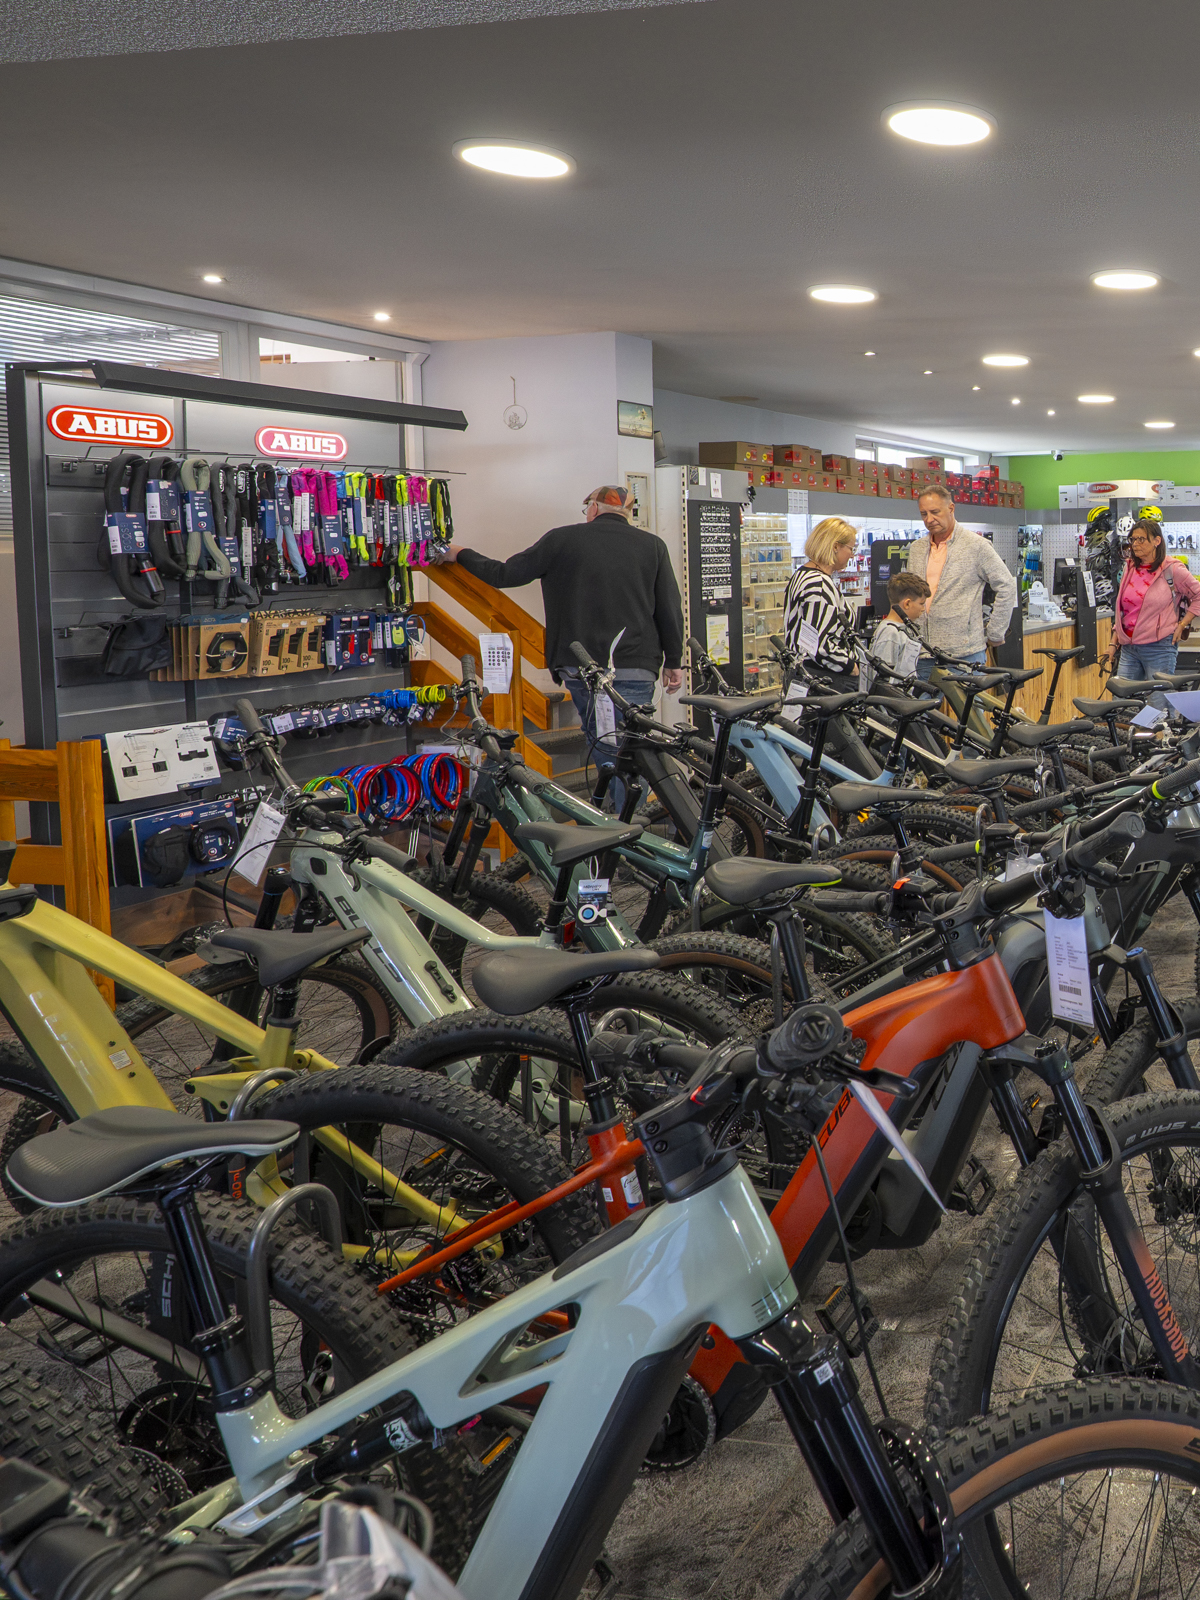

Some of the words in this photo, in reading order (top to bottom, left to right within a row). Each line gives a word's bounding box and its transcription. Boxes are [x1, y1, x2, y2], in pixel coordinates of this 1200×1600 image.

[68, 414, 158, 439] ABUS
[270, 433, 337, 454] ABUS
[818, 1085, 855, 1151] CUB
[1140, 1121, 1186, 1139] SAM
[1144, 1270, 1189, 1363] ROCKSHOX
